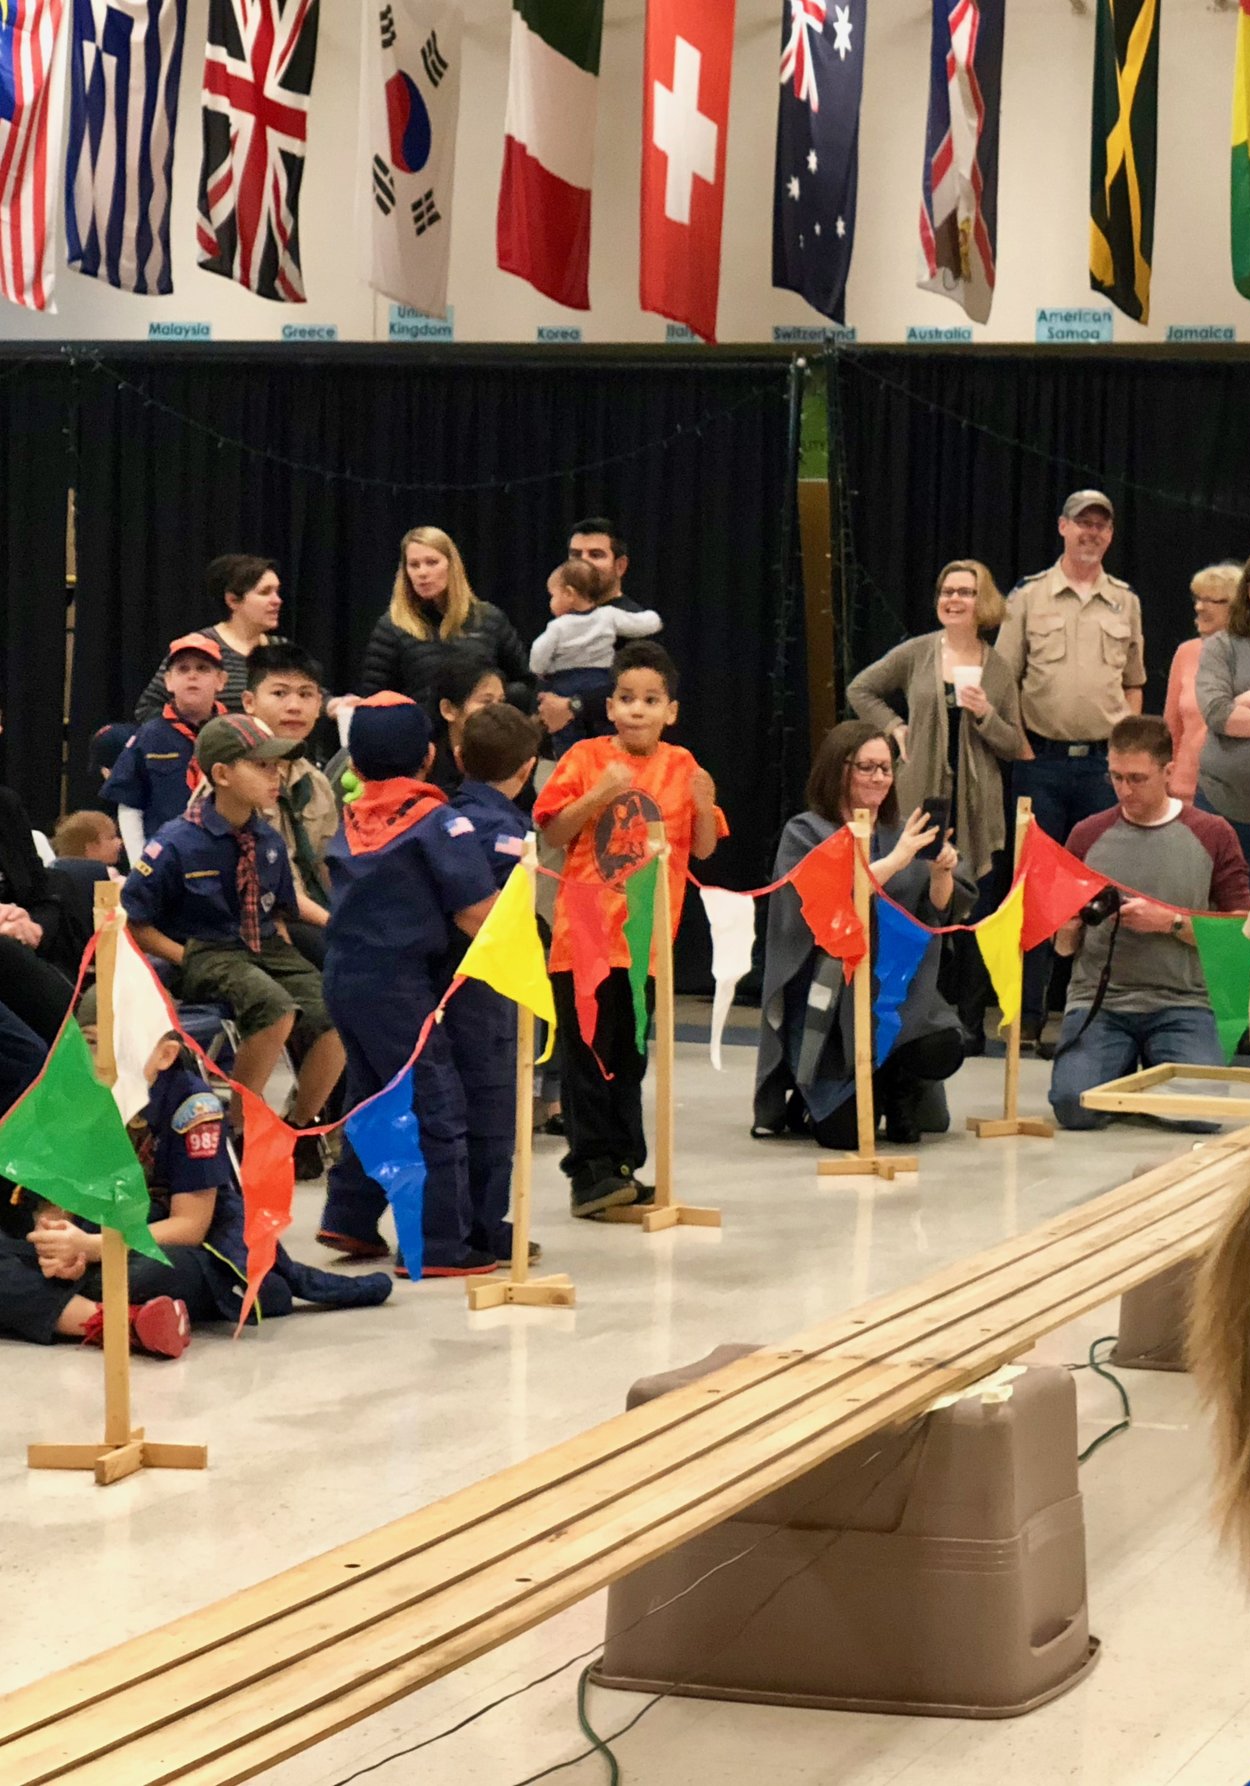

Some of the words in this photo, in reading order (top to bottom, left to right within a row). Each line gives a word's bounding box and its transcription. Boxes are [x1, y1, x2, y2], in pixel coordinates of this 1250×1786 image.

[1037, 310, 1112, 323] American
[149, 322, 210, 338] Malaysia
[282, 325, 335, 338] Greece
[389, 321, 452, 338] Kingdom
[537, 326, 580, 340] Korea
[907, 327, 971, 340] Australia
[1047, 326, 1100, 340] Samoa
[1166, 326, 1233, 340] Jamaica
[189, 1131, 219, 1151] 985
